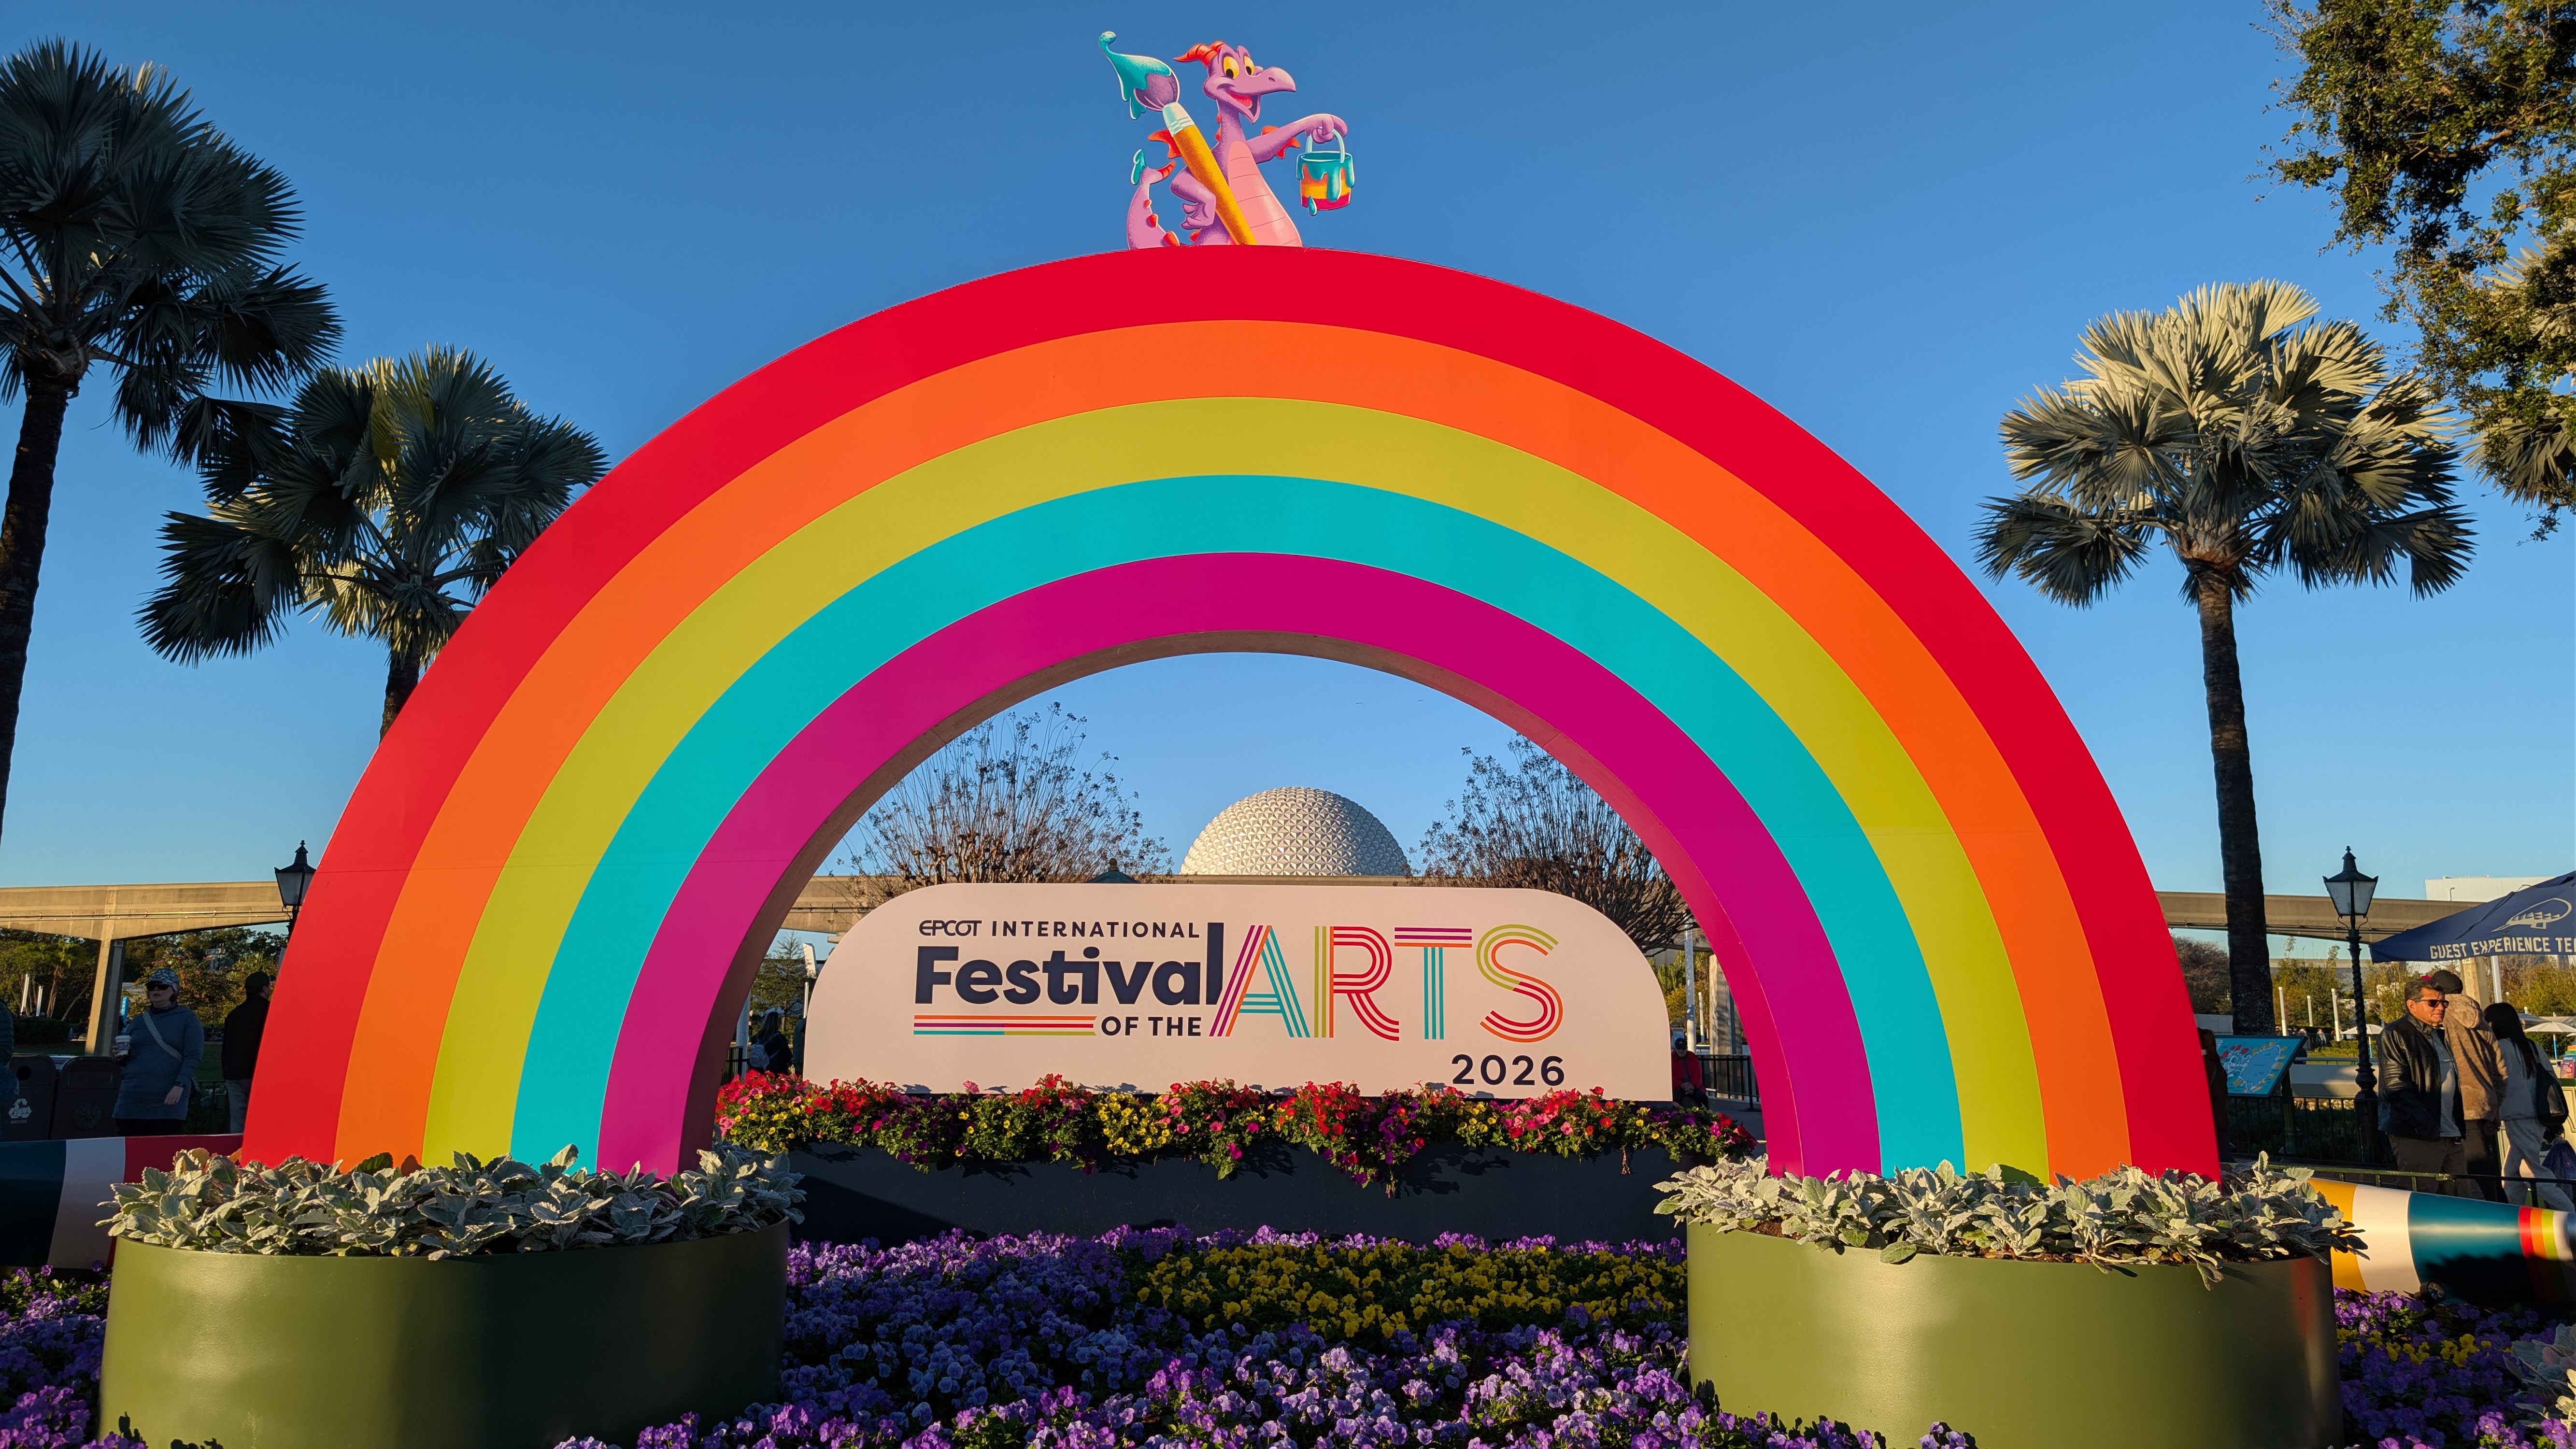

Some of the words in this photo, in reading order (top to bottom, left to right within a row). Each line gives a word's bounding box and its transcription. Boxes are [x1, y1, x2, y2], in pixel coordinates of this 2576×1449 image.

[919, 920, 982, 937] EPCOT
[992, 921, 1199, 938] INTERNATIONAL
[2430, 942, 2467, 959] GUEST
[2471, 937, 2551, 956] EXPERIENCE
[915, 922, 1224, 1006] Festival
[1209, 923, 1564, 1043] ARTS
[1101, 1016, 1139, 1036] OF
[1148, 1017, 1201, 1037] THE
[1452, 1054, 1565, 1086] 2026
